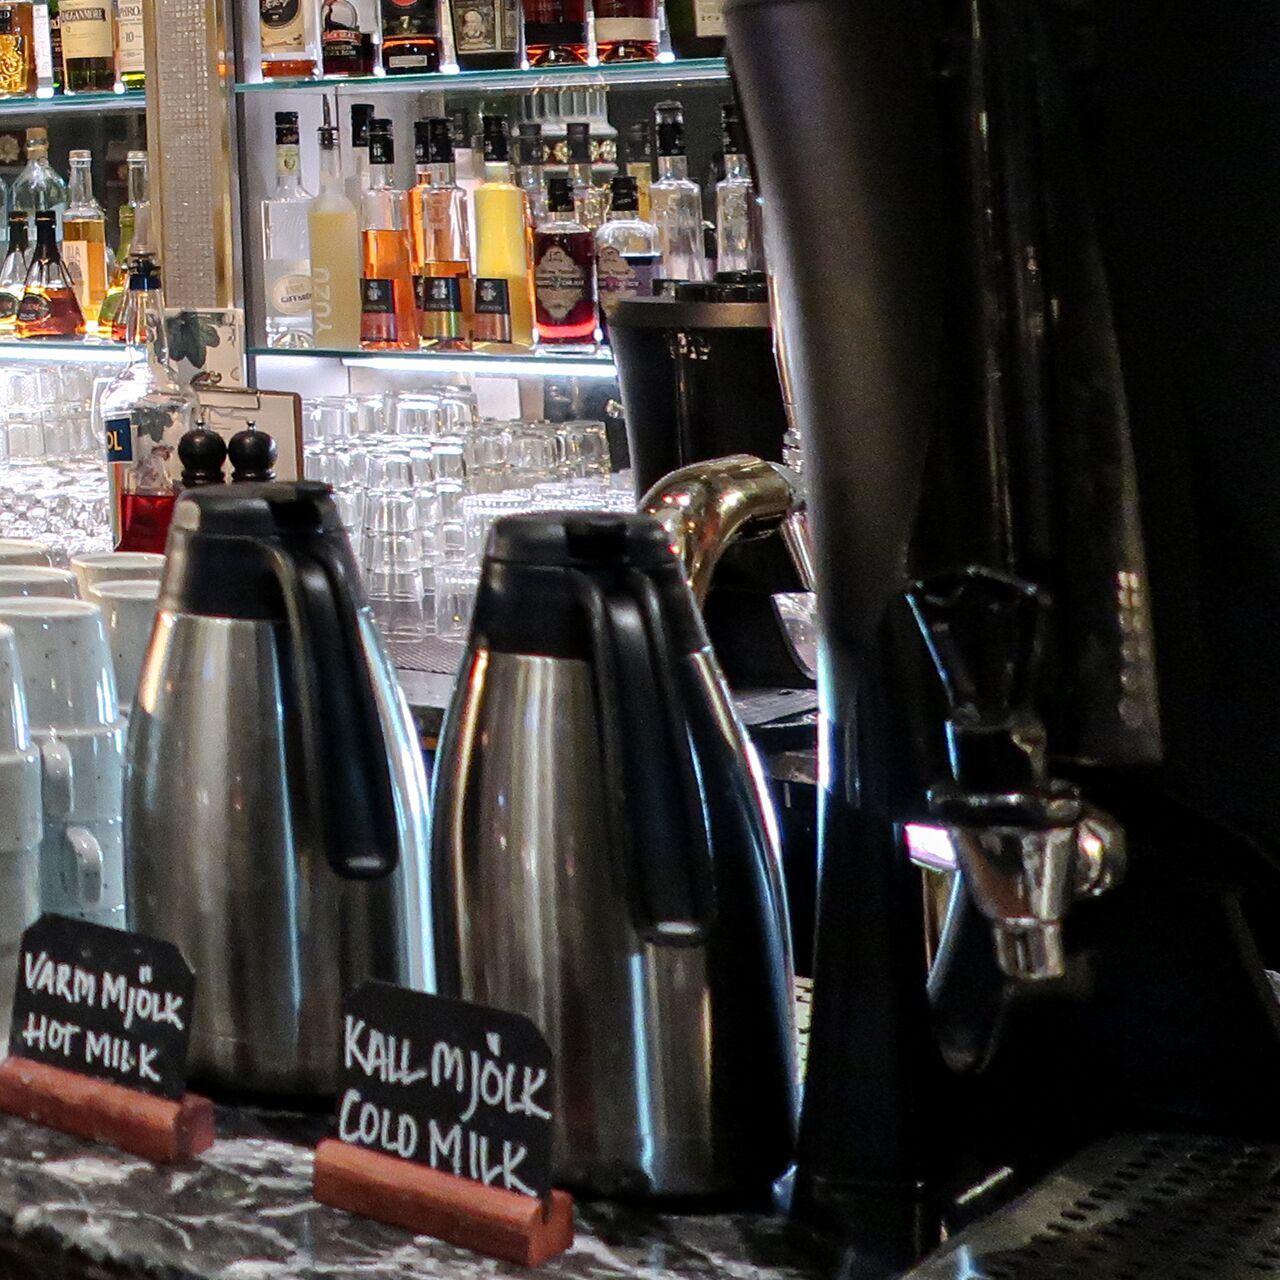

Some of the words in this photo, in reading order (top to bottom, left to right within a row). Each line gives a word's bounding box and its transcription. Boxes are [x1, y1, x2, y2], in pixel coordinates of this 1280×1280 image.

[125, 32, 134, 42] 10
[400, 15, 410, 28] 7
[314, 267, 333, 333] YUZU
[23, 950, 96, 1002] VARM
[101, 965, 184, 1030] MJÖLK
[22, 1012, 81, 1055] HOT
[84, 1028, 162, 1082] MILK
[344, 1014, 426, 1085] KALL
[430, 1031, 551, 1121] MJÖLK
[339, 1089, 417, 1158] COLD
[428, 1118, 538, 1197] MILK
